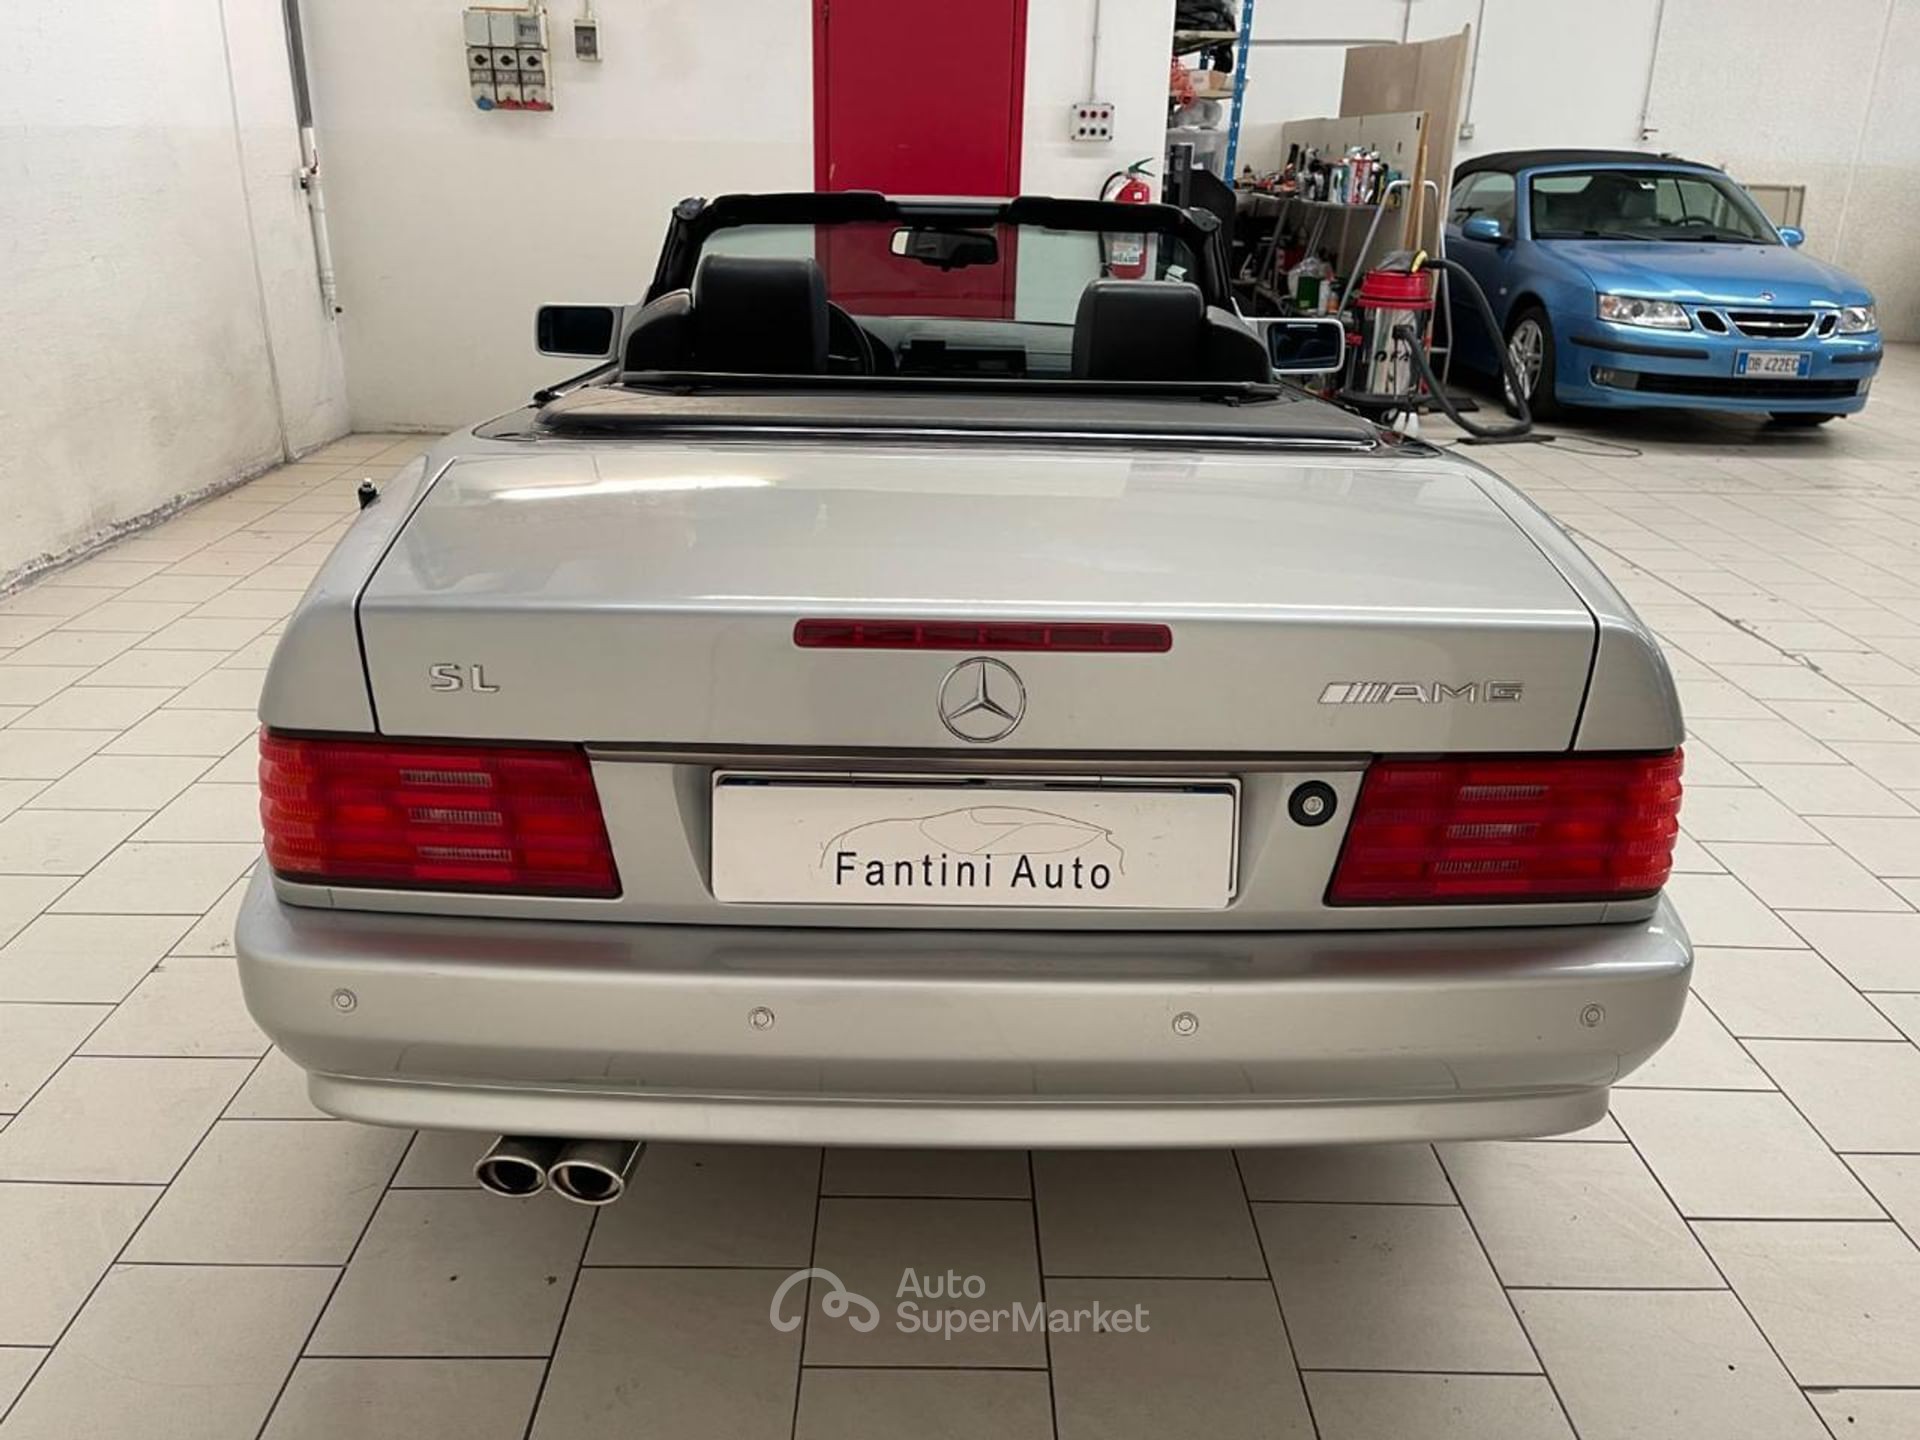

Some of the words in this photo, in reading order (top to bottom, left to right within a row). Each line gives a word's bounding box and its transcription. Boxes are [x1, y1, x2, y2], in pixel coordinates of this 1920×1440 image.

[429, 663, 500, 693] SL
[1384, 680, 1524, 703] AMG
[836, 851, 992, 887] Fantini
[1010, 854, 1111, 889] Auto
